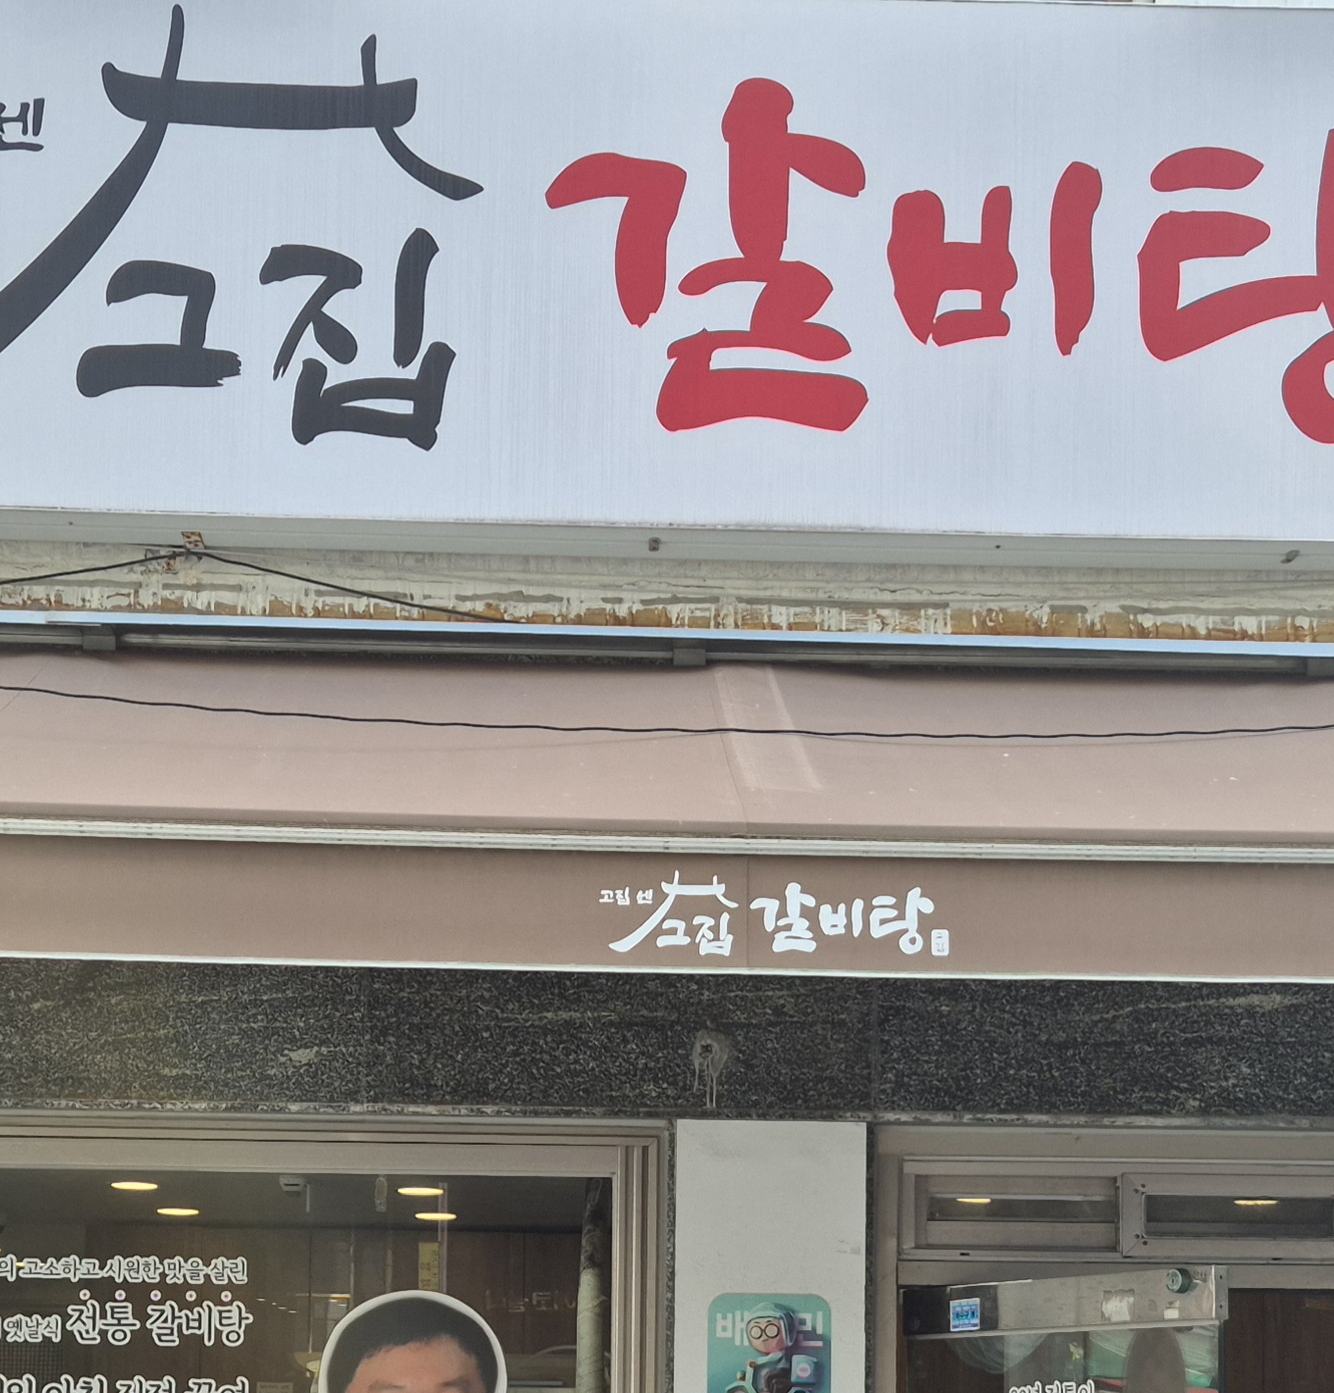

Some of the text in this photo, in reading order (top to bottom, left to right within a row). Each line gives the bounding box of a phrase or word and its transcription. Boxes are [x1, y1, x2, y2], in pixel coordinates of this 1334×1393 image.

[76, 226, 457, 452] 그집
[598, 888, 630, 906] 고집
[656, 911, 734, 957] 그집
[749, 881, 935, 956] 갈비탕
[21, 1257, 101, 1281] 고소하고
[104, 1257, 164, 1282] 시원한
[165, 1258, 208, 1283] 맛을
[210, 1258, 248, 1283] 살린
[4, 1316, 62, 1342] 옛날식
[67, 1301, 141, 1344] 전통
[146, 1301, 253, 1346] 갈비탕
